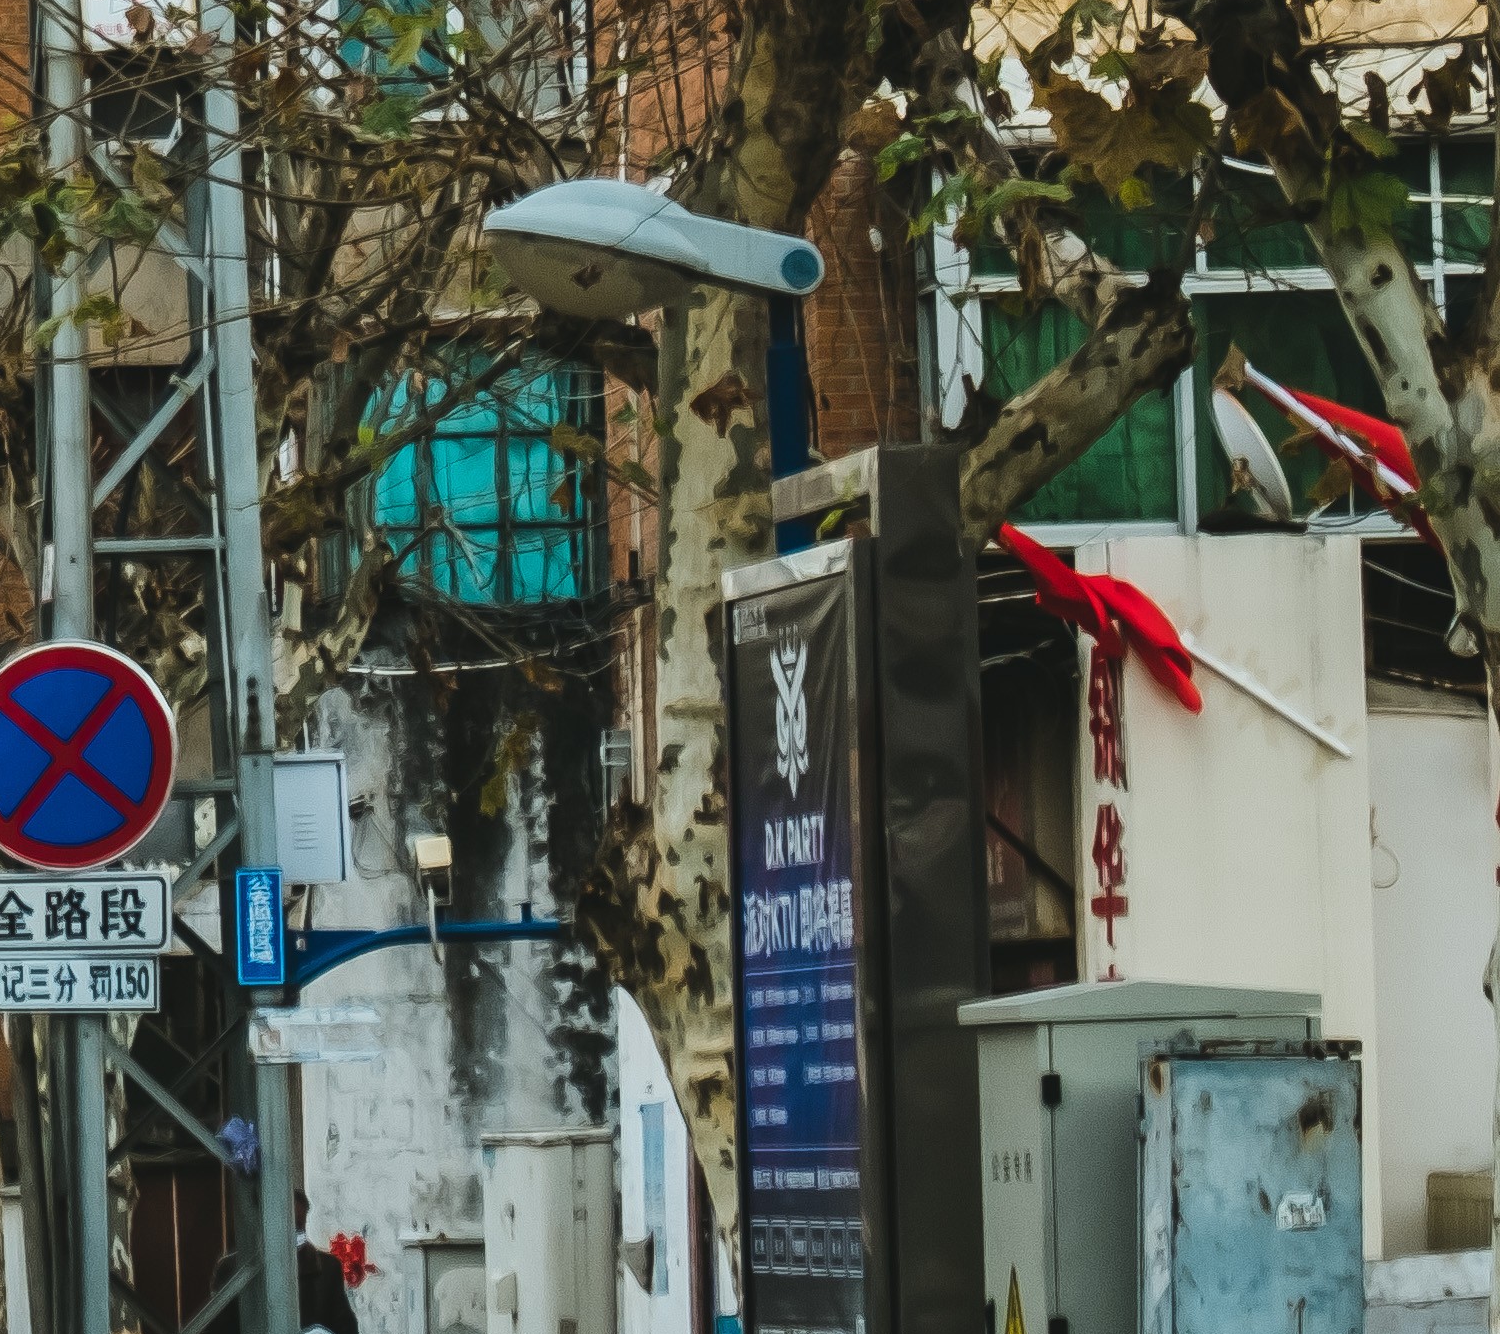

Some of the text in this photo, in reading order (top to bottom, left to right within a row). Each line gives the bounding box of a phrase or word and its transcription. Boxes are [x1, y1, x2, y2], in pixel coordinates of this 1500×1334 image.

[2, 963, 151, 1003] 记三分 罚150
